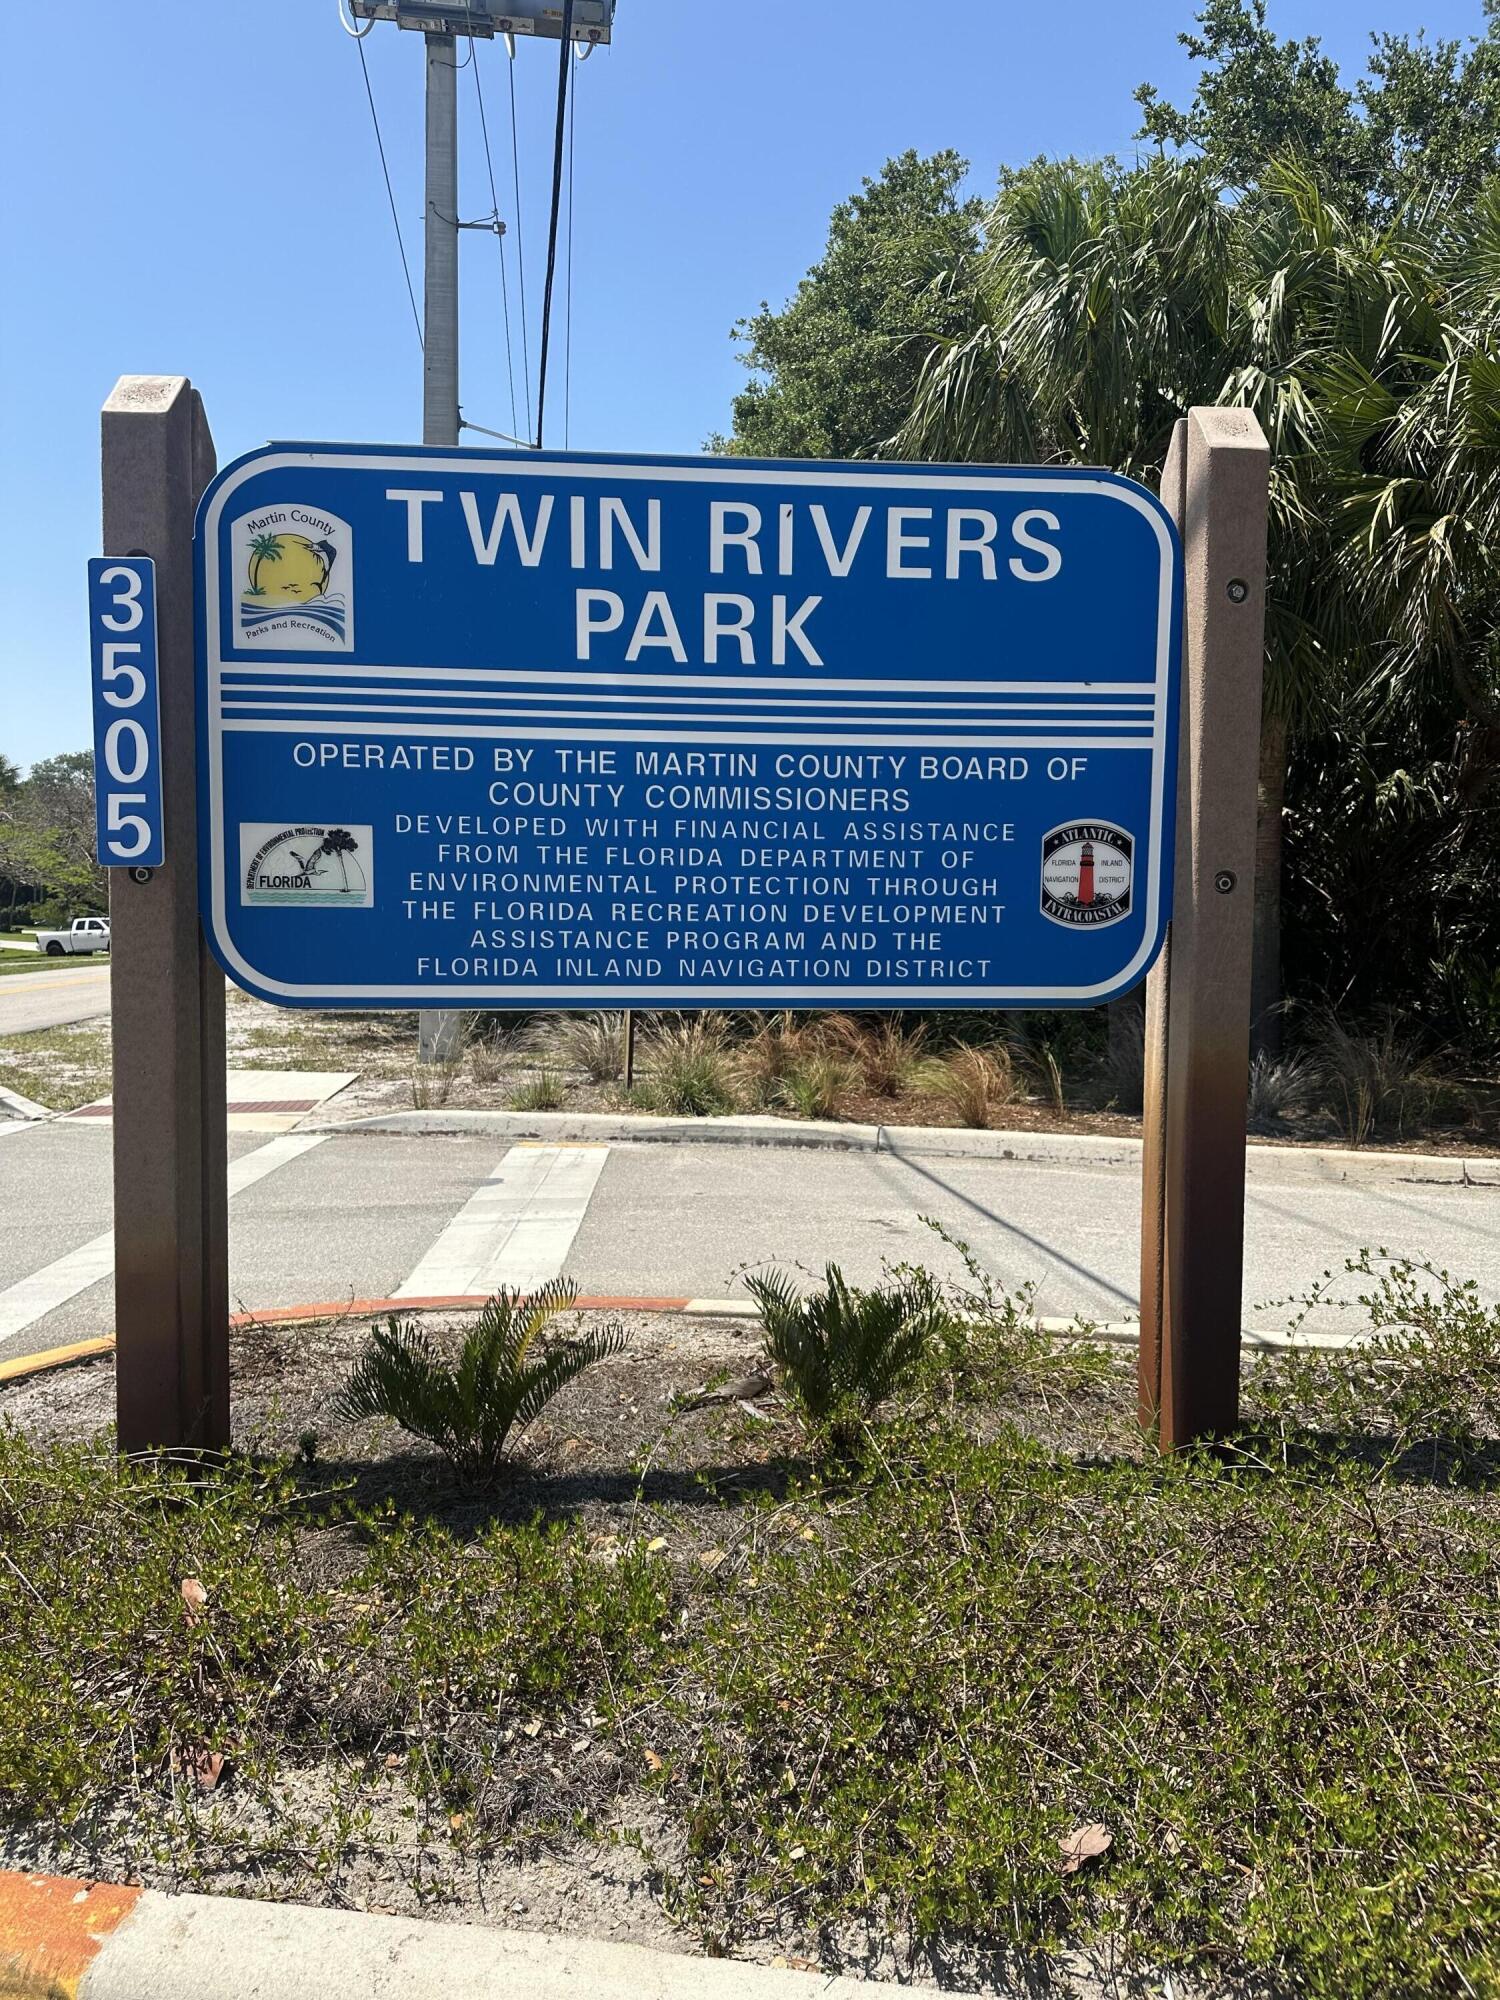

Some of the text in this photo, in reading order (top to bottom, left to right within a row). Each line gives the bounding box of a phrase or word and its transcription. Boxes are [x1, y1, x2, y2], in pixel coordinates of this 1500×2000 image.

[246, 509, 336, 537] Martin County
[385, 489, 1062, 582] TWIN RIVERS
[245, 619, 336, 643] Parks and Recreation
[575, 588, 824, 666] PARK
[99, 565, 152, 859] 3505
[293, 742, 1088, 781] OPERATED BY THE MARTIN COUNTY BOARD OF
[489, 781, 910, 812] COUNTY COMMISSIONERS
[396, 814, 1014, 841] DEVELOPED WITH FINANCIAL ASSISTANCE
[1061, 827, 1117, 841] ATLANTIC
[438, 844, 974, 869] FROM THE FLORIDA DEPARTMENT OF
[1051, 859, 1123, 867] FLORIDA INLAND
[259, 875, 312, 889] FLORIDA
[410, 872, 997, 896] ENVIRONMENTAL PROTECTION THROUGH
[1098, 876, 1126, 884] DISTRICT
[402, 900, 1005, 923] THE FLORIDA RECREATION DEVELOPMENT
[1044, 899, 1126, 922] INTRACOASTAL
[470, 929, 941, 951] ASSISTANCE PROGRAM AND THE
[418, 957, 991, 978] FLORIDA INLAND NAVIGATION DISTRICT
